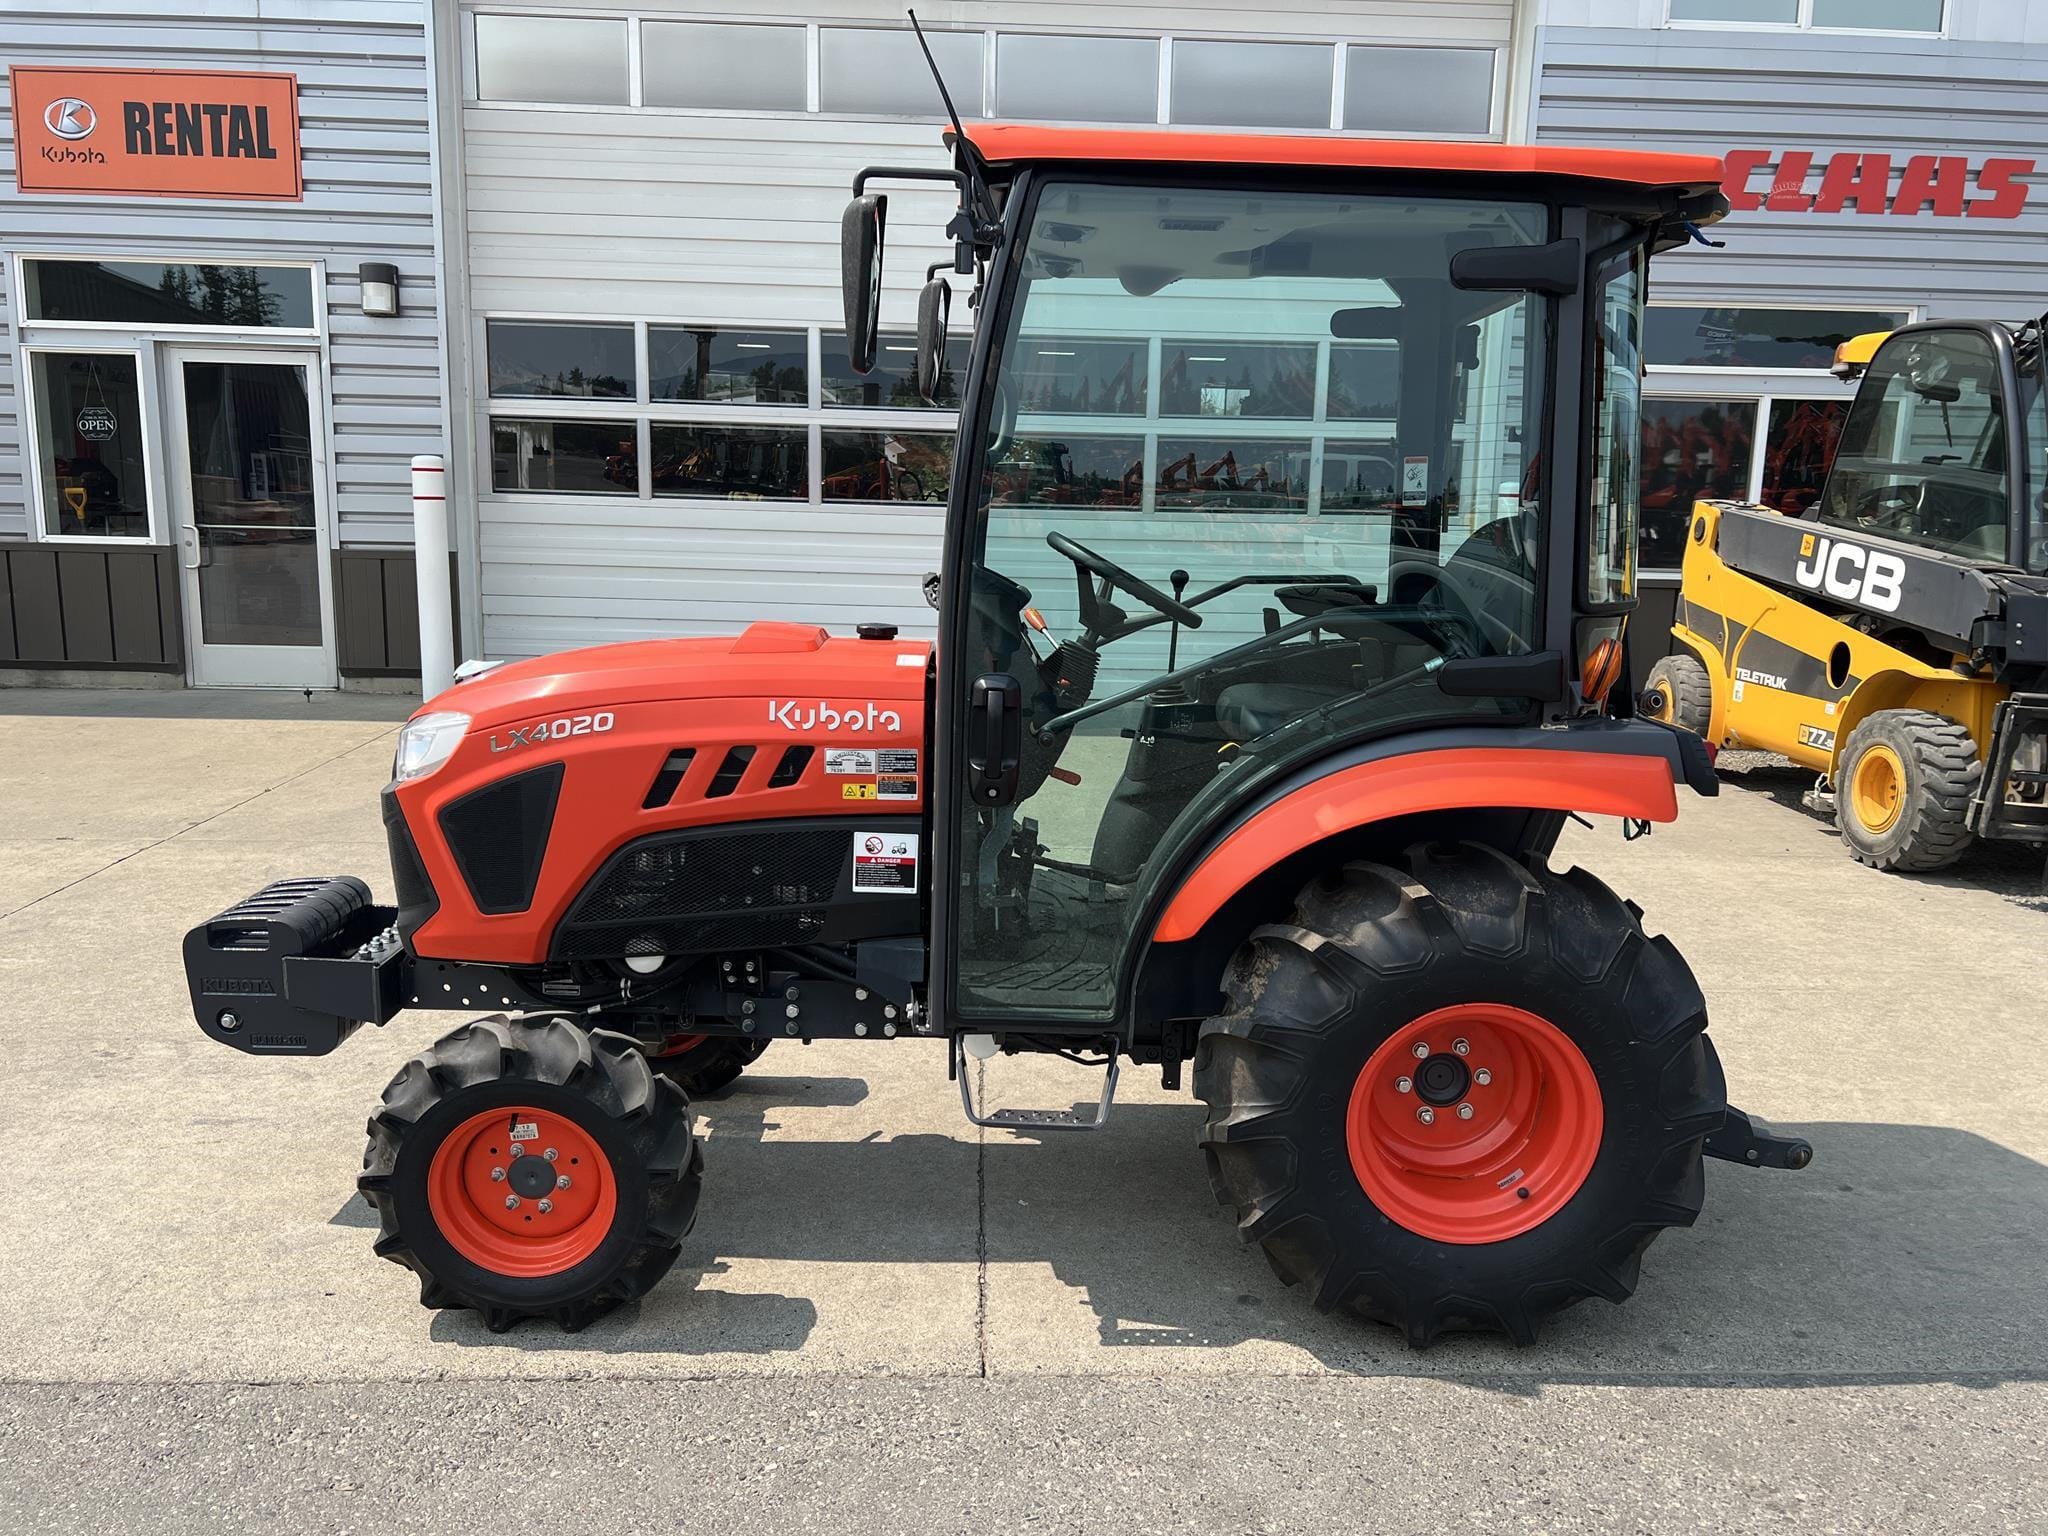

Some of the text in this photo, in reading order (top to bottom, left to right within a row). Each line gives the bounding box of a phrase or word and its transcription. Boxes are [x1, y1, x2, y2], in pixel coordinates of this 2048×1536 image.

[123, 101, 277, 159] RENTAL
[42, 146, 105, 164] Kubota
[1720, 149, 2036, 219] CLAAS
[79, 419, 114, 431] OPEN
[1795, 537, 1906, 613] JCB
[1736, 667, 1788, 690] TELETRUK
[768, 700, 901, 731] Kubota
[489, 712, 615, 753] LX4020
[200, 977, 275, 993] KUBOTA
